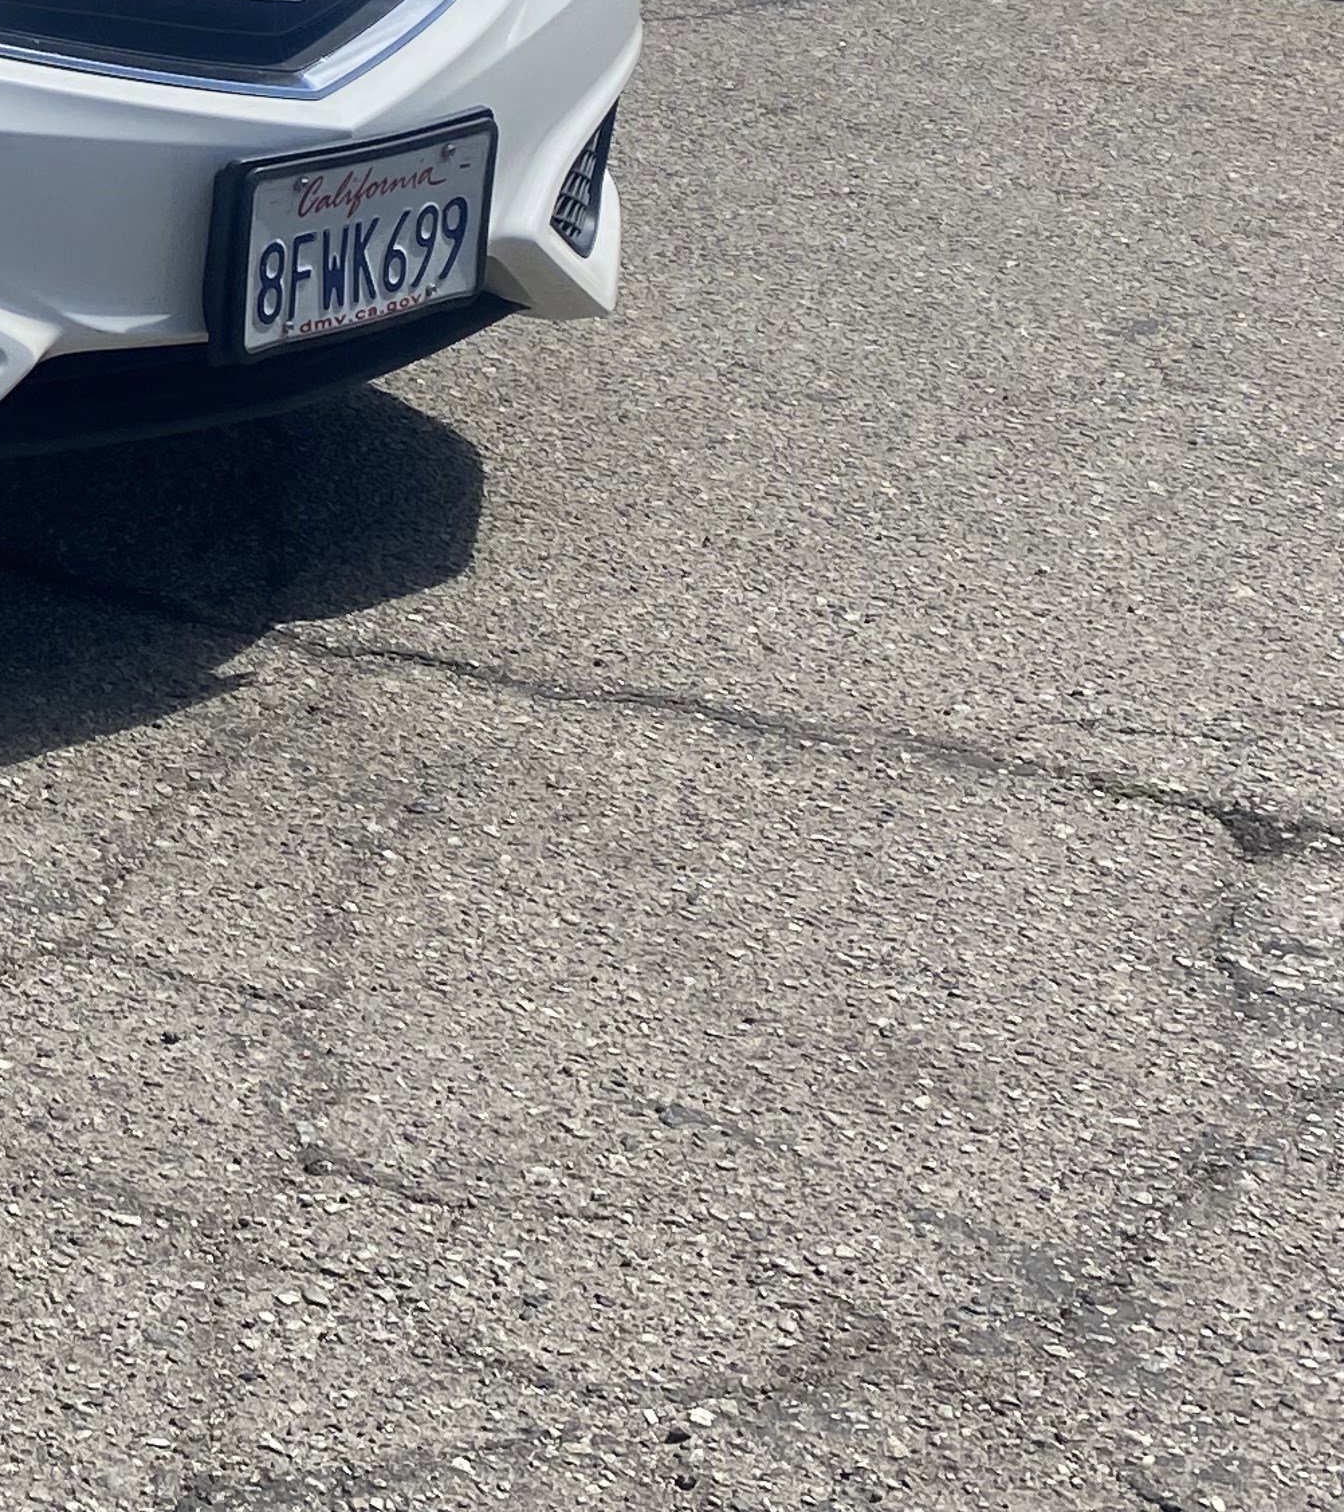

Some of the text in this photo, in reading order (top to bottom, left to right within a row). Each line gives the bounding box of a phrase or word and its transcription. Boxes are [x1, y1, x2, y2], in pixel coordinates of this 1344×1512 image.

[297, 166, 446, 219] California
[257, 196, 469, 325] 8FWK699
[299, 294, 422, 334] dmv.ca.gov
